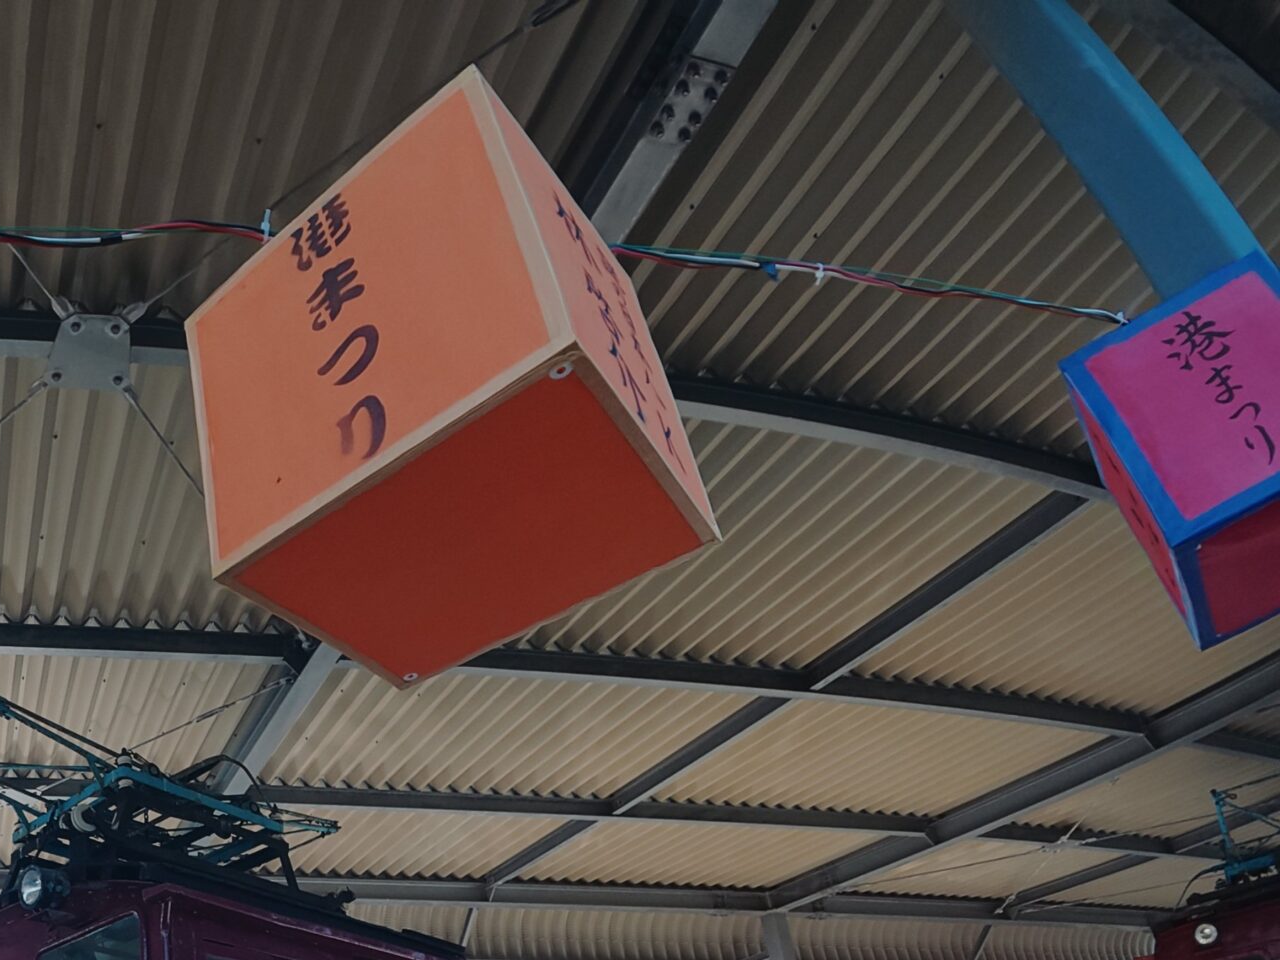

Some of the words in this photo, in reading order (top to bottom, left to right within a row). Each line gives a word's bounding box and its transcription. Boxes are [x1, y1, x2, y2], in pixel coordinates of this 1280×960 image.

[290, 192, 387, 460] 港まつり
[1161, 311, 1276, 466] 港まつり
